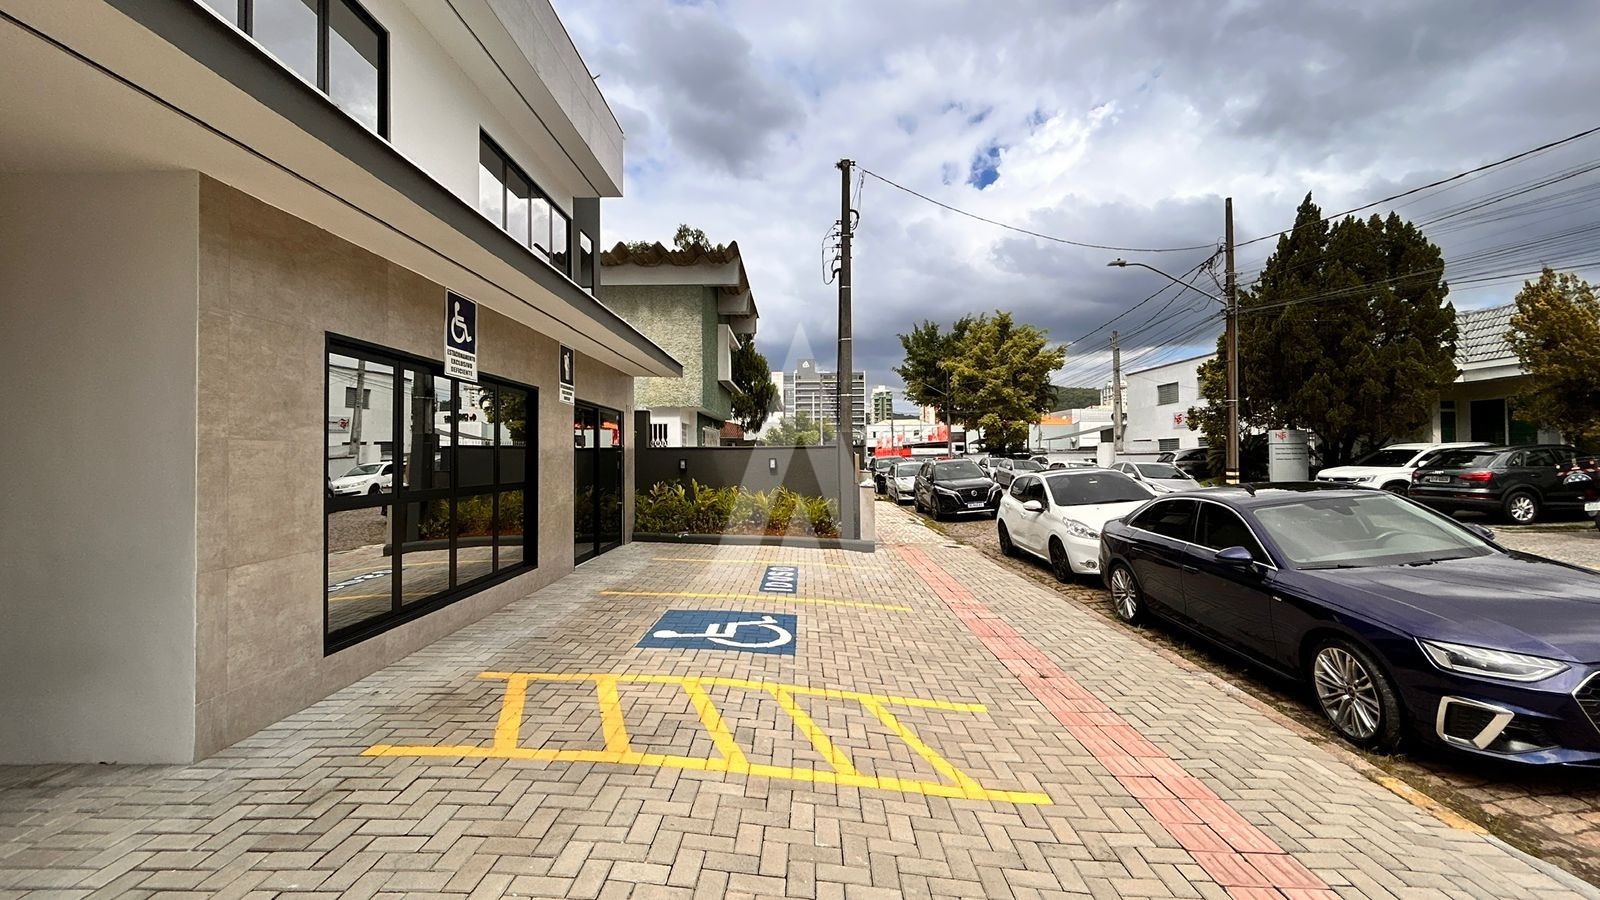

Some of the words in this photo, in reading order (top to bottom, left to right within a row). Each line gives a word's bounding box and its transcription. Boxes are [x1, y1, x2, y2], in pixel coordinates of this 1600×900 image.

[447, 349, 475, 362] ESTACIONAMENTO
[451, 358, 472, 369] EXCLUSIVO
[451, 366, 472, 376] DEFICIENTE
[764, 567, 794, 592] IDOSO
